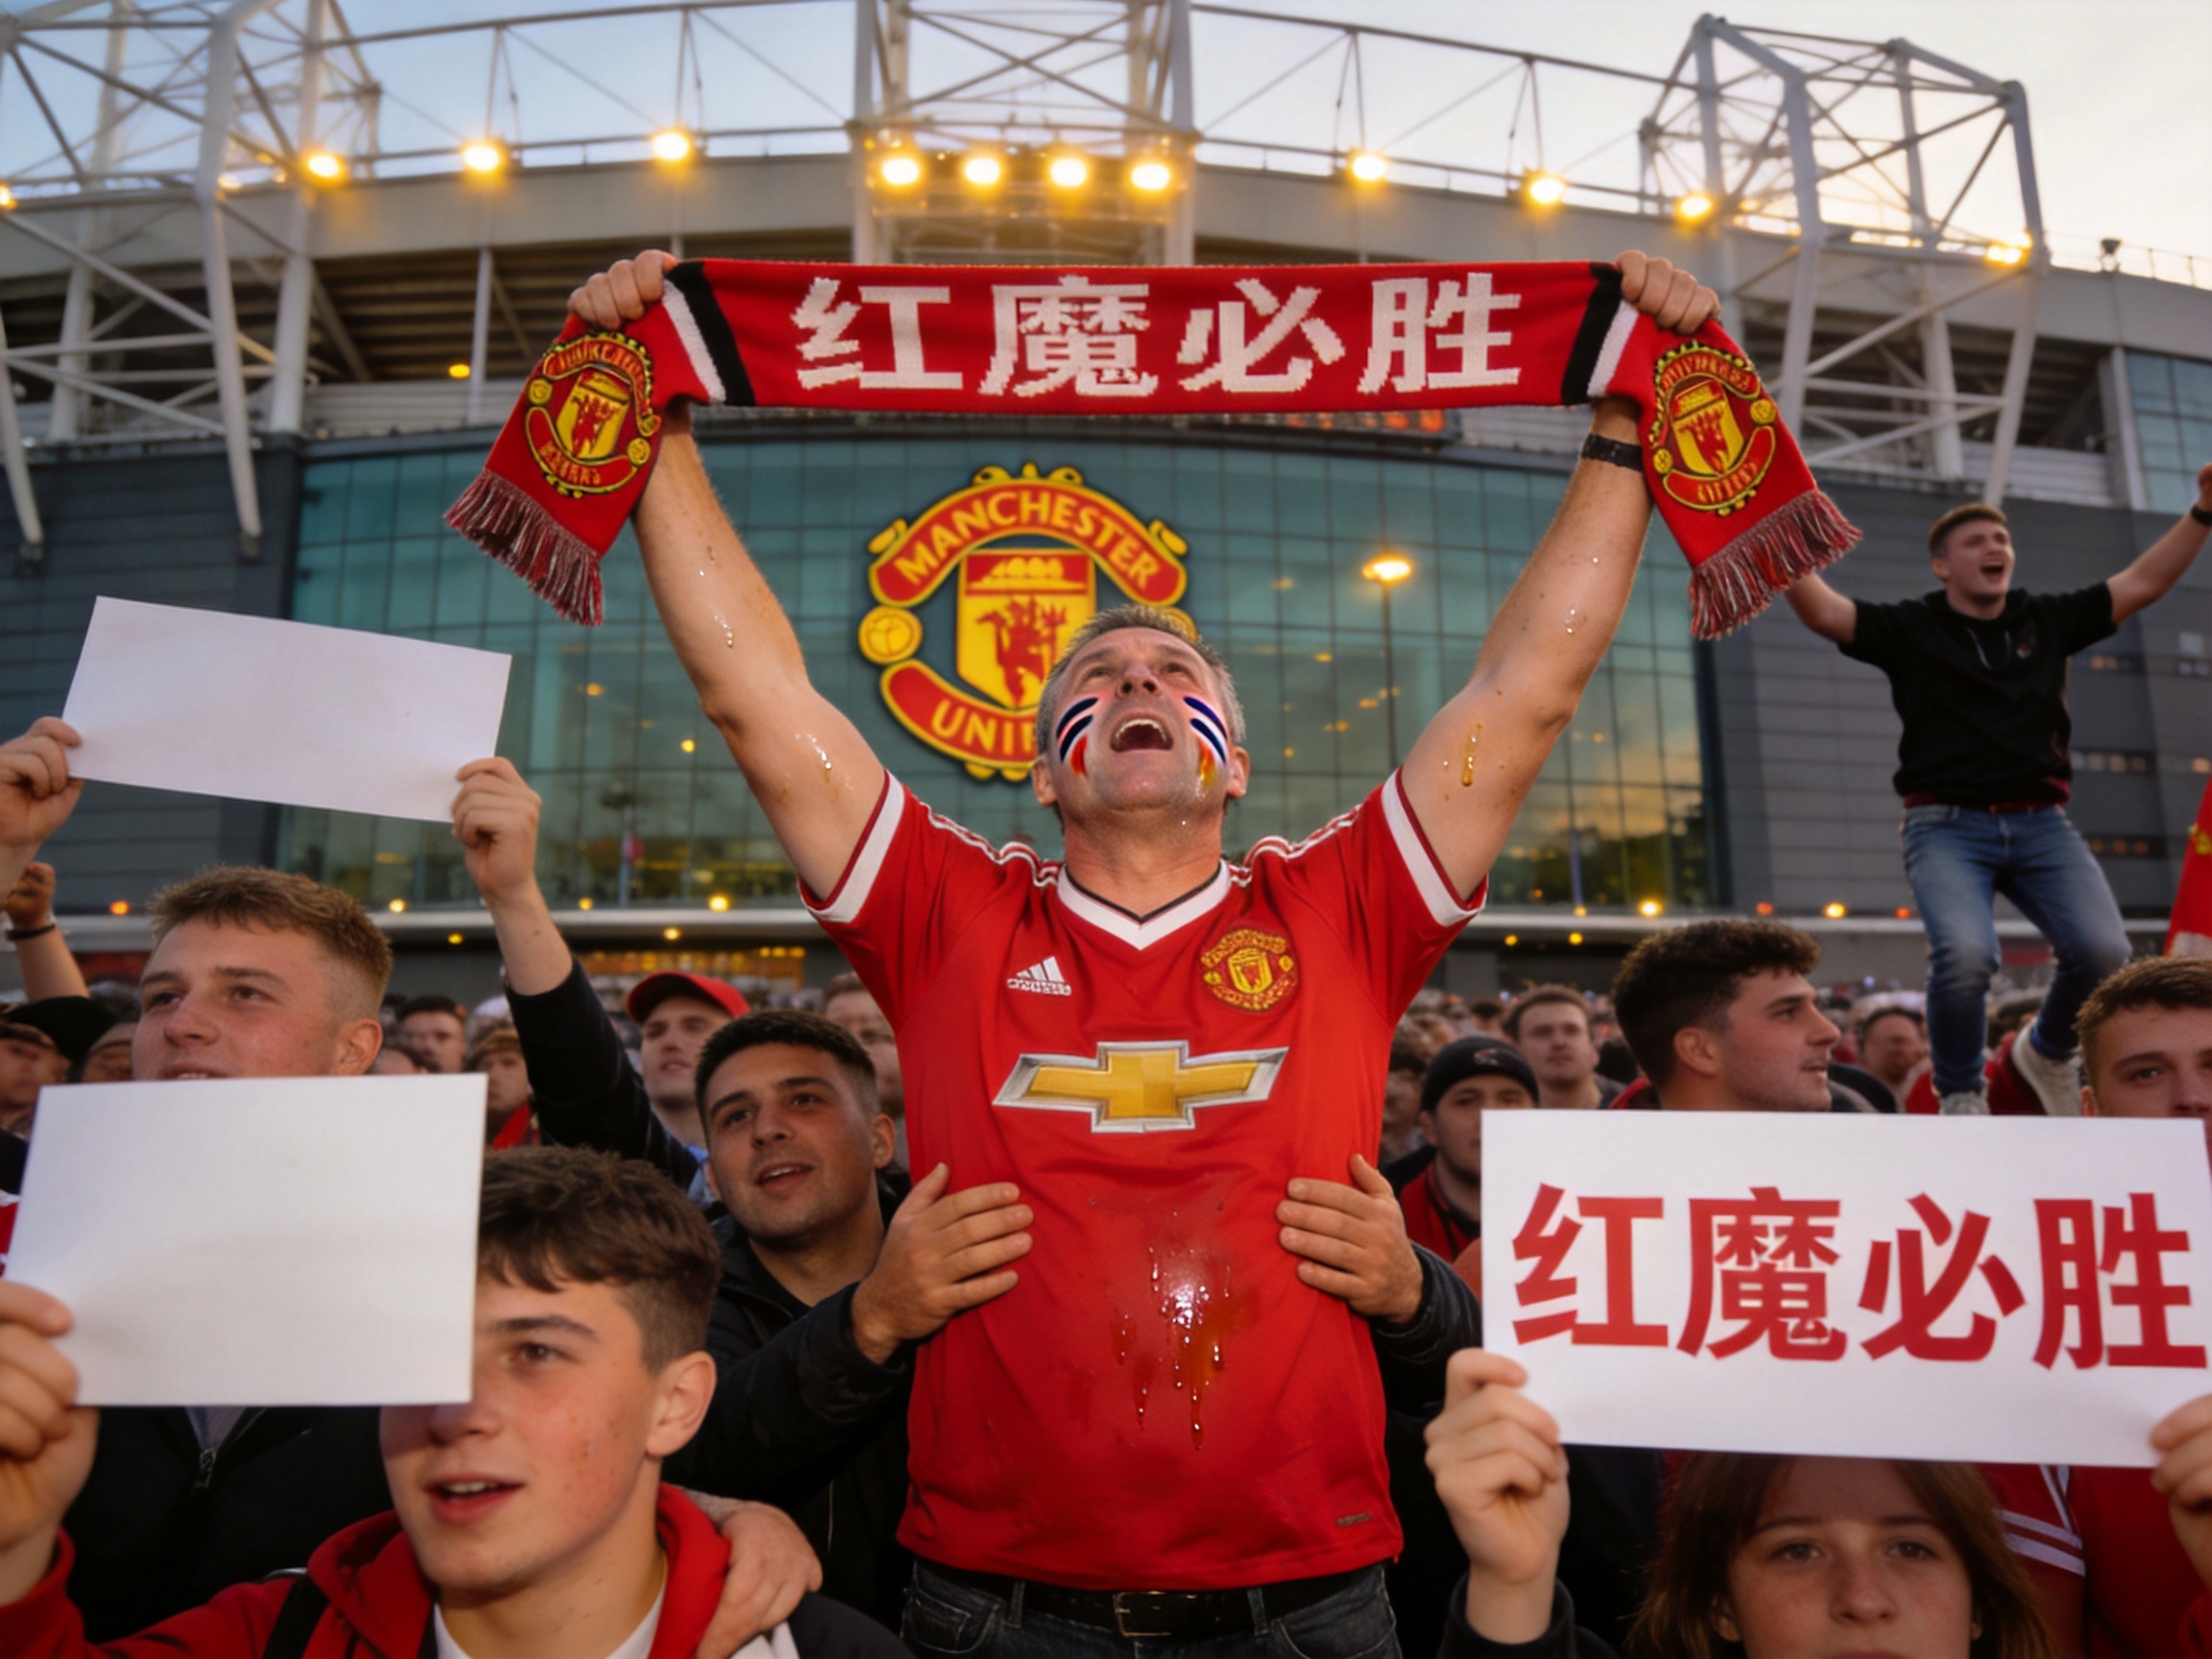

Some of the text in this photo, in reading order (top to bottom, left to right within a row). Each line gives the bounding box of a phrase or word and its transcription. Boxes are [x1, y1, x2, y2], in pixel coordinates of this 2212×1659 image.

[791, 273, 1522, 397] 红魔必胜
[894, 490, 1159, 589] MANCHESTER
[1512, 1183, 2207, 1370] 红魔必胜
